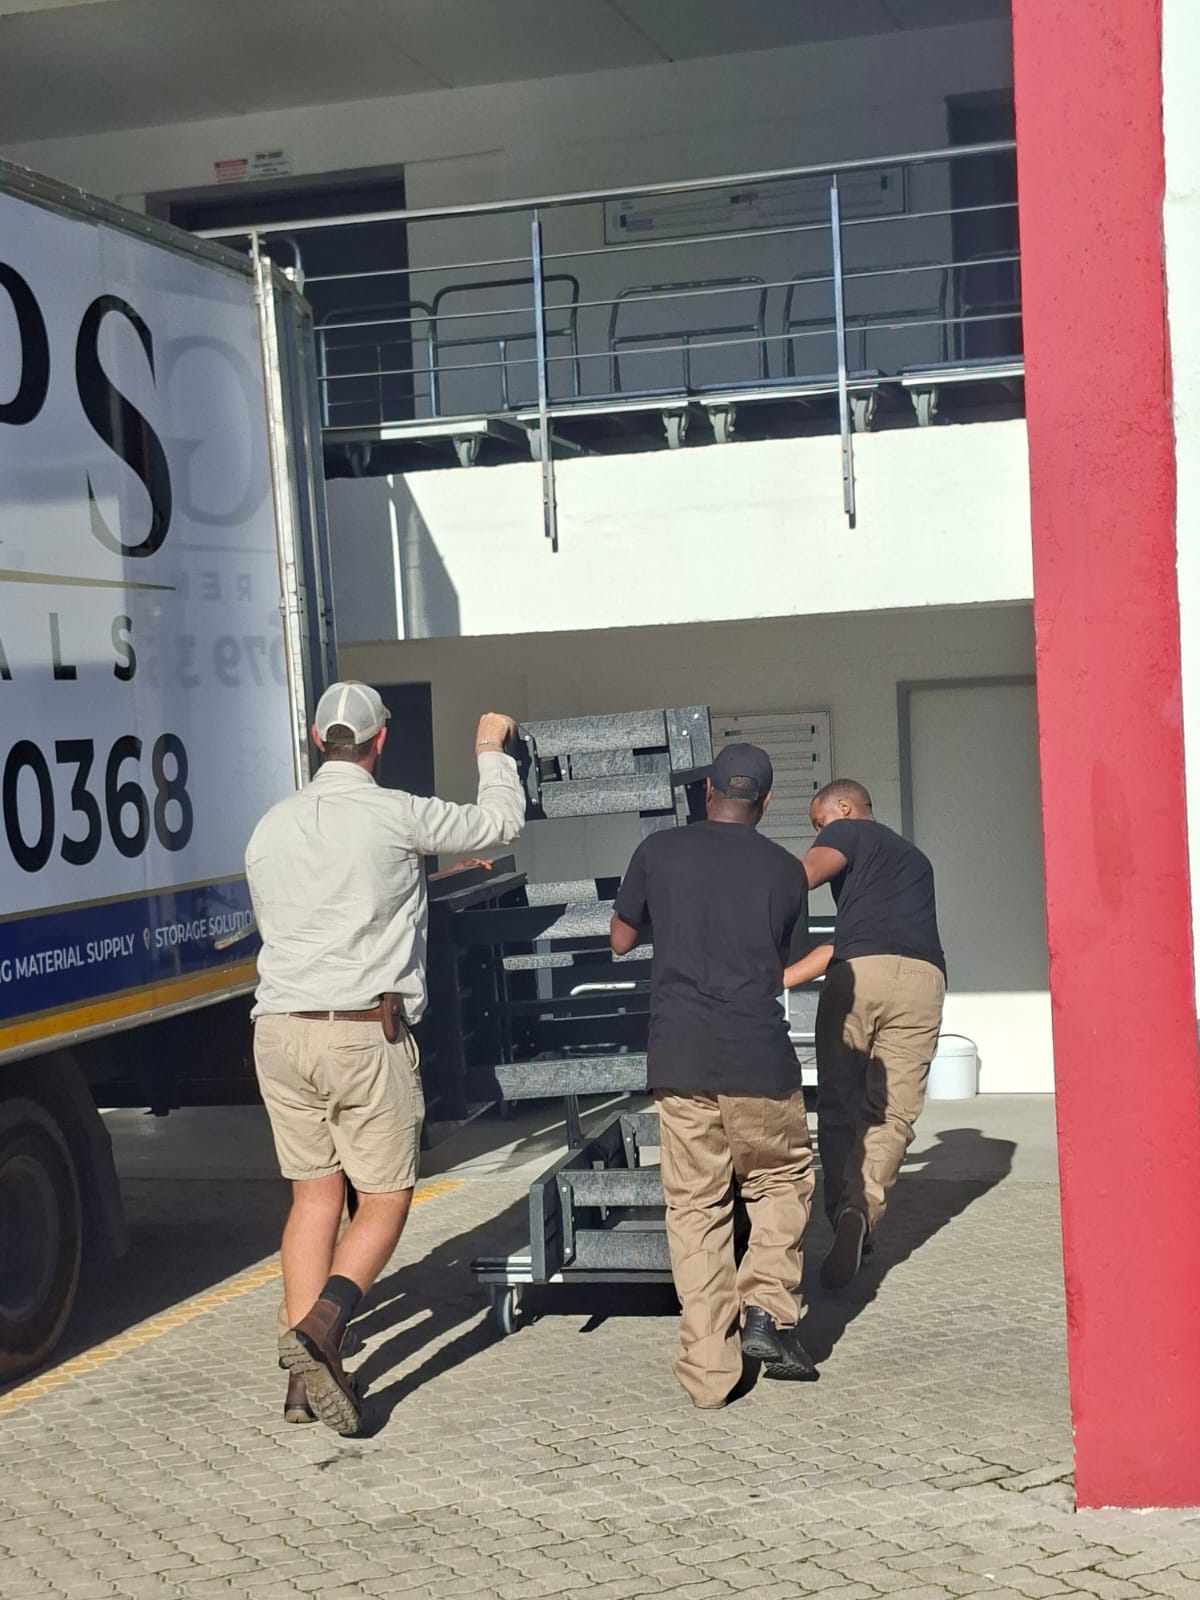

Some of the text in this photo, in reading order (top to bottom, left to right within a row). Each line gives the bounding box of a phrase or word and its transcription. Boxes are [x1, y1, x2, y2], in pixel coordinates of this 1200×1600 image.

[2, 732, 194, 873] 0368
[0, 910, 254, 983] G MATERIAL SUPPLY STORAGE SOLUTIO
